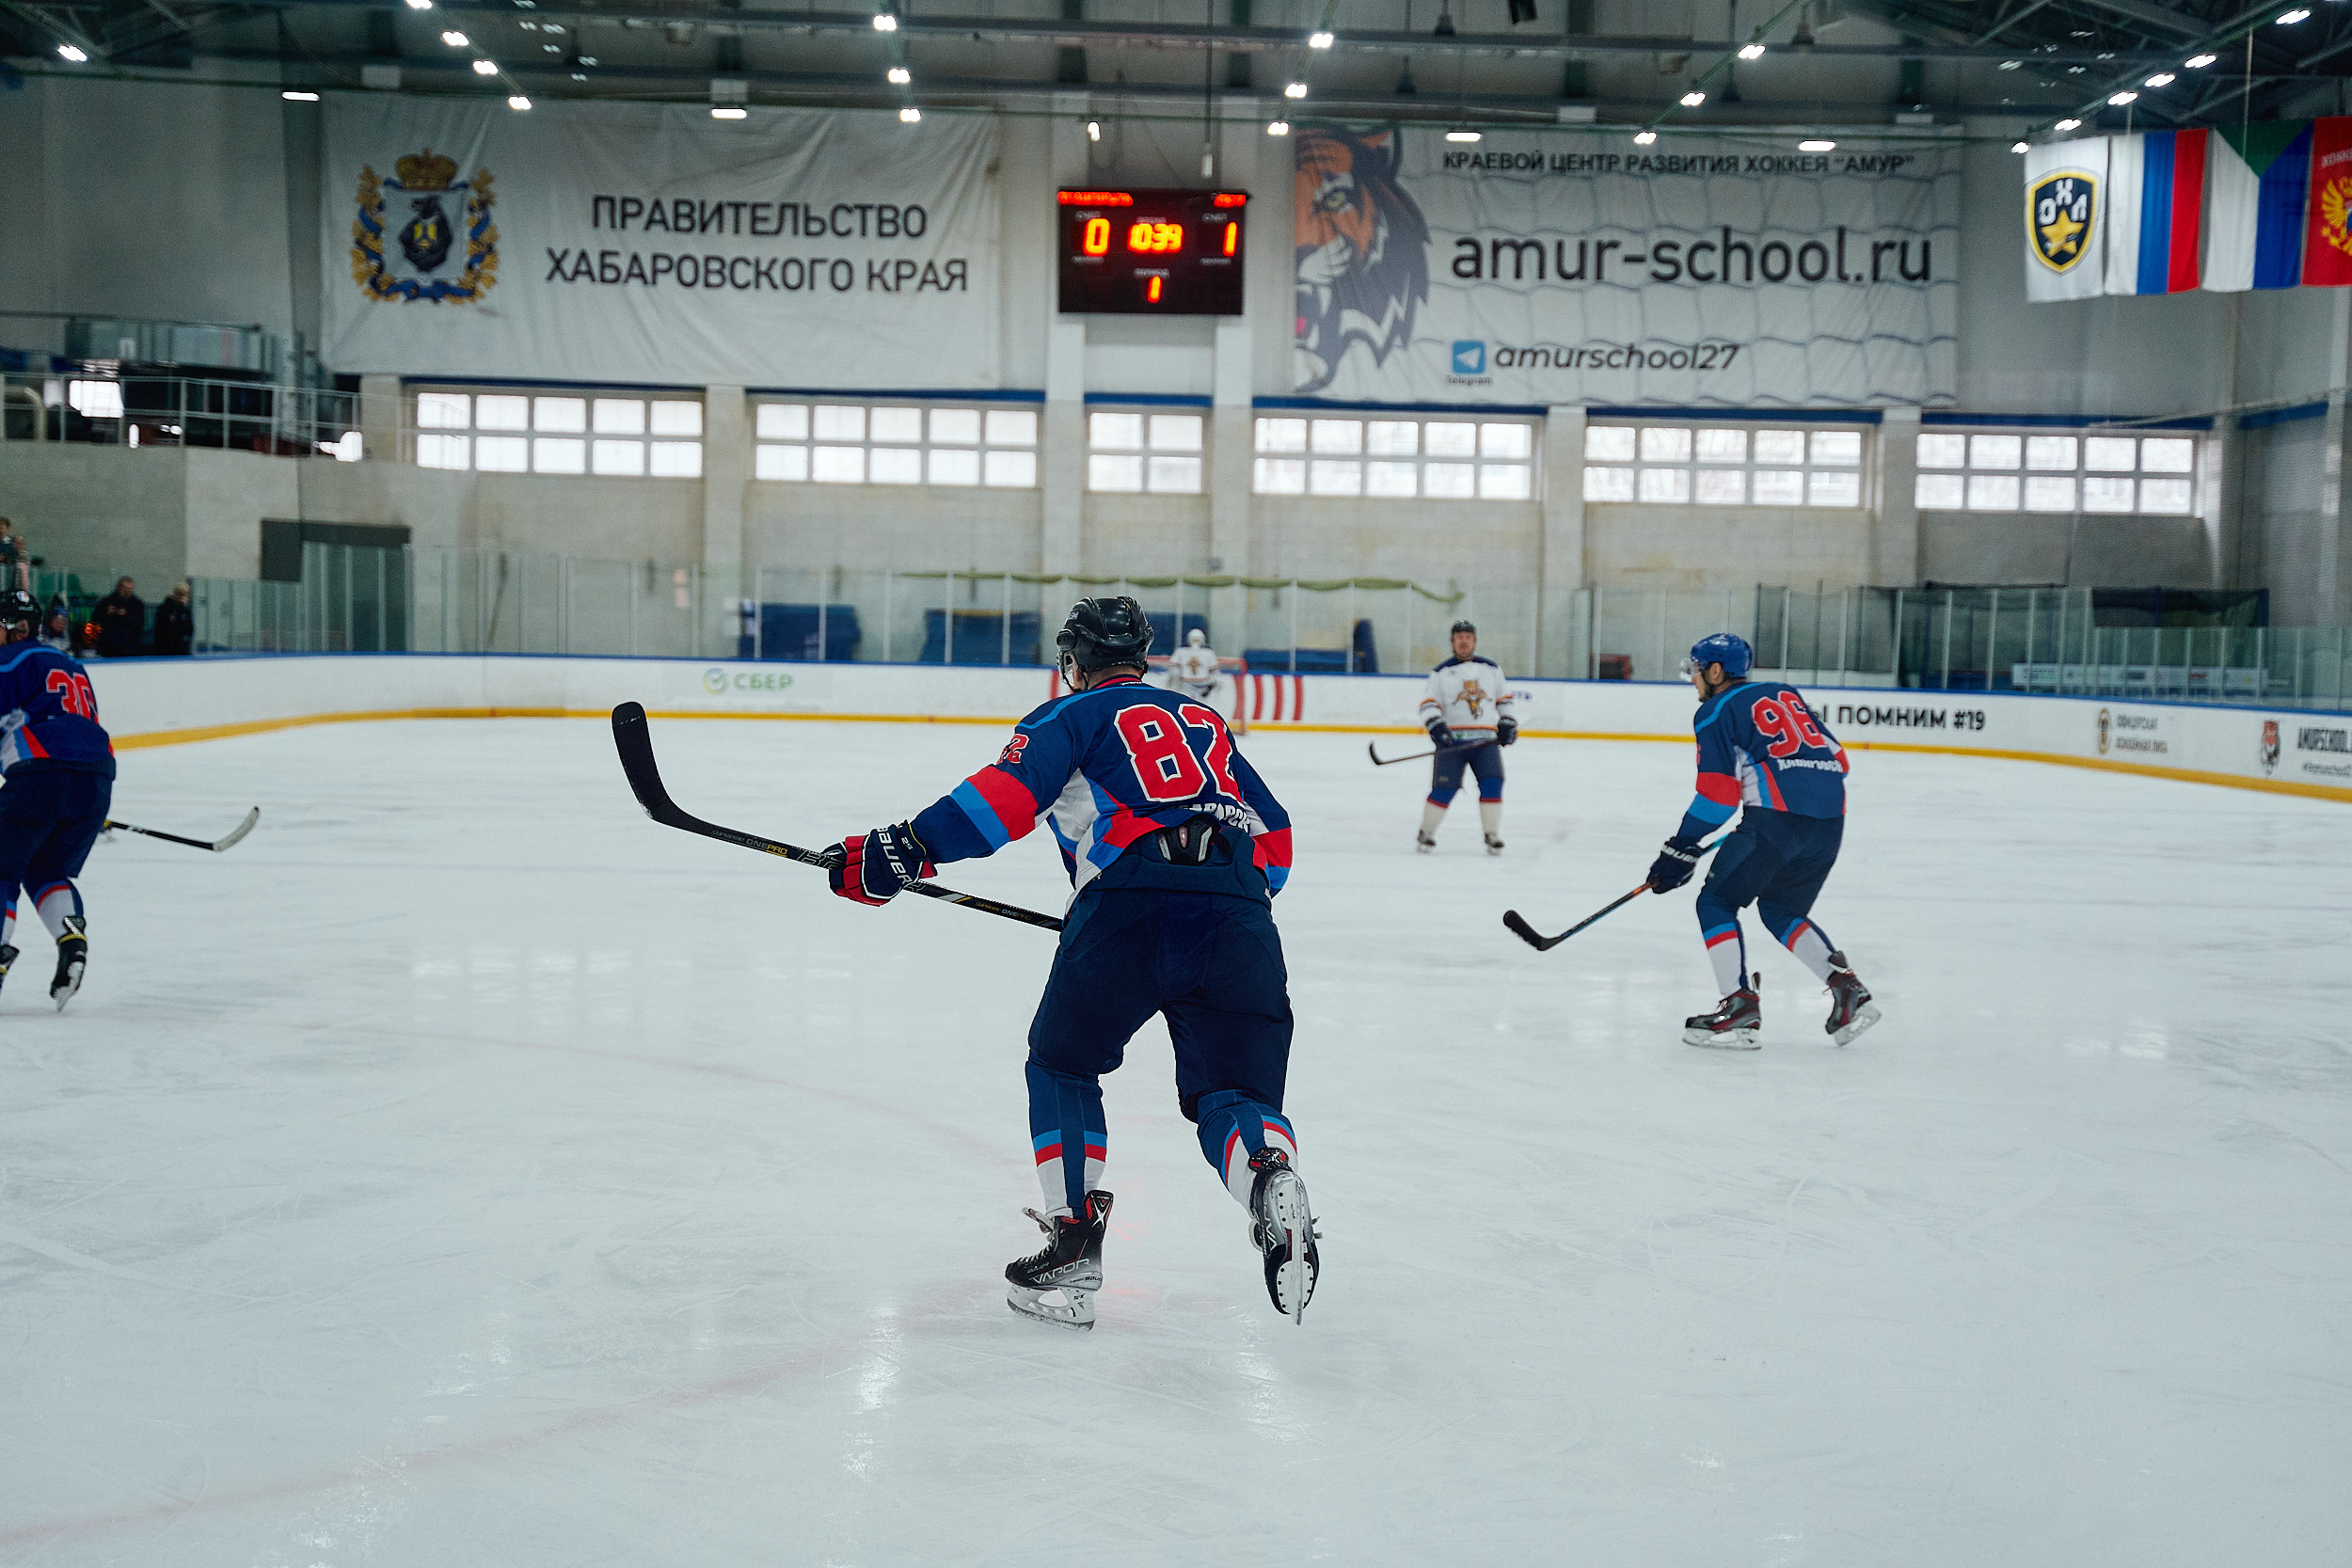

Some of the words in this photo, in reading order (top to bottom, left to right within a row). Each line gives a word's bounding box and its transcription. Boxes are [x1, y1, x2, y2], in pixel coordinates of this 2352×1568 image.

[1442, 150, 1545, 170] КРАЕВОЙ
[1551, 153, 1621, 175] ЦЕНТР
[1625, 153, 1738, 172] РАЗВИТИЯ
[1743, 154, 1828, 172] ХОККЕЯ
[592, 195, 928, 239] ПРАВИТЕЛЬСТВО
[545, 247, 854, 292] ХАБАРОВСКОГО
[866, 258, 968, 292] КРАЯ
[1451, 224, 1932, 283] amur-school.ru
[1494, 341, 1740, 372] amurschool27
[733, 672, 795, 691] СБЕР
[1752, 689, 1829, 759] 96
[1838, 705, 1947, 729] ПОМНИМ
[1954, 708, 1986, 730] #19
[996, 733, 1030, 765] 2
[1114, 704, 1244, 806] 82
[1028, 1258, 1090, 1284] VAPOR
